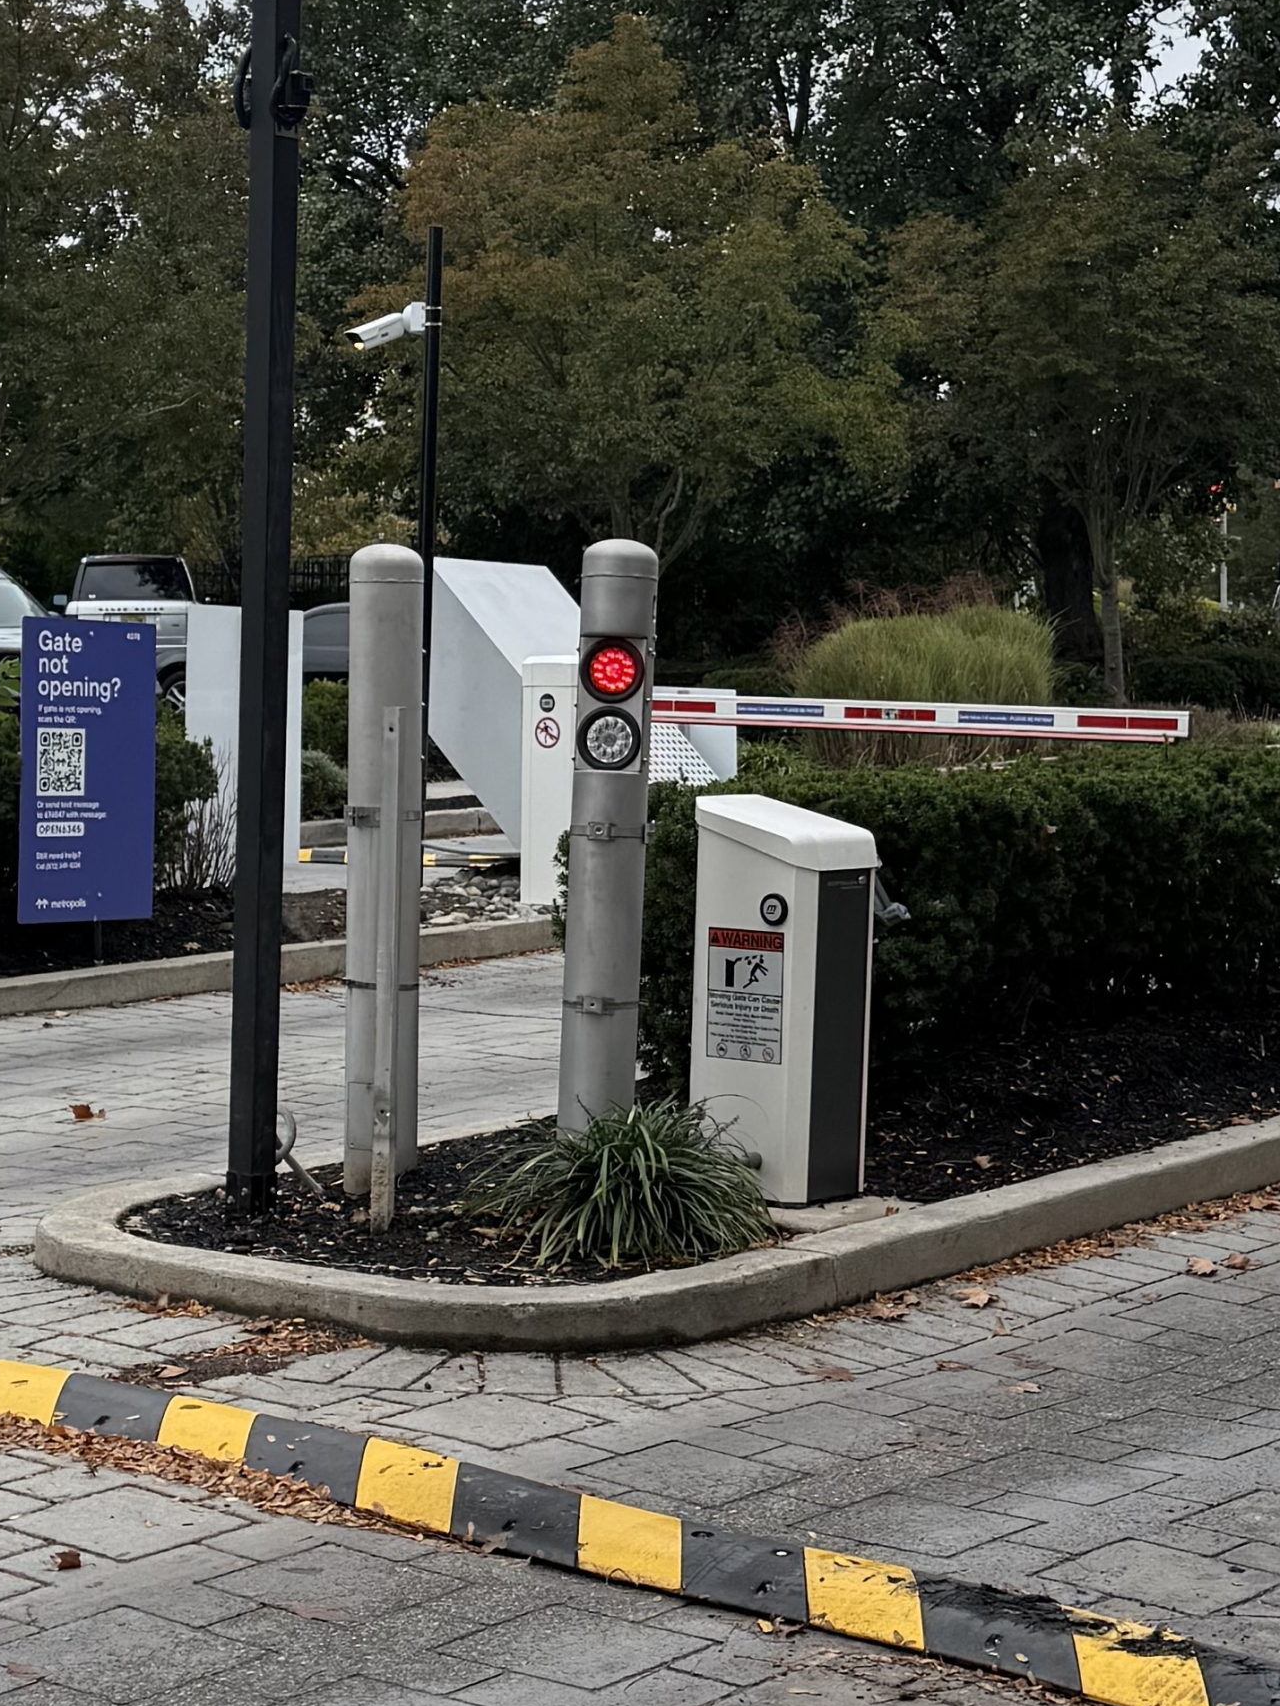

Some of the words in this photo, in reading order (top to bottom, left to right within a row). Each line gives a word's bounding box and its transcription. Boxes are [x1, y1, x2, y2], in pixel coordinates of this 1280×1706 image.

[38, 630, 82, 653] Gate
[38, 654, 69, 675] not
[38, 676, 121, 703] opening?
[44, 705, 58, 714] gate
[65, 705, 76, 713] not
[53, 715, 64, 723] the
[36, 801, 44, 809] Or
[45, 801, 60, 809] send
[73, 801, 100, 810] message
[36, 811, 43, 819] to
[66, 811, 79, 819] with
[36, 851, 48, 860] Still
[48, 852, 64, 860] need
[64, 851, 82, 861] help?
[50, 898, 87, 910] metropolis
[721, 931, 783, 949] WARNING
[710, 992, 731, 1001] Moving
[732, 993, 747, 1002] Gate
[748, 994, 760, 1003] Can
[761, 995, 781, 1004] Cause
[710, 1000, 734, 1010] Serious
[735, 1002, 752, 1012] Injury
[761, 1004, 780, 1014] Death
